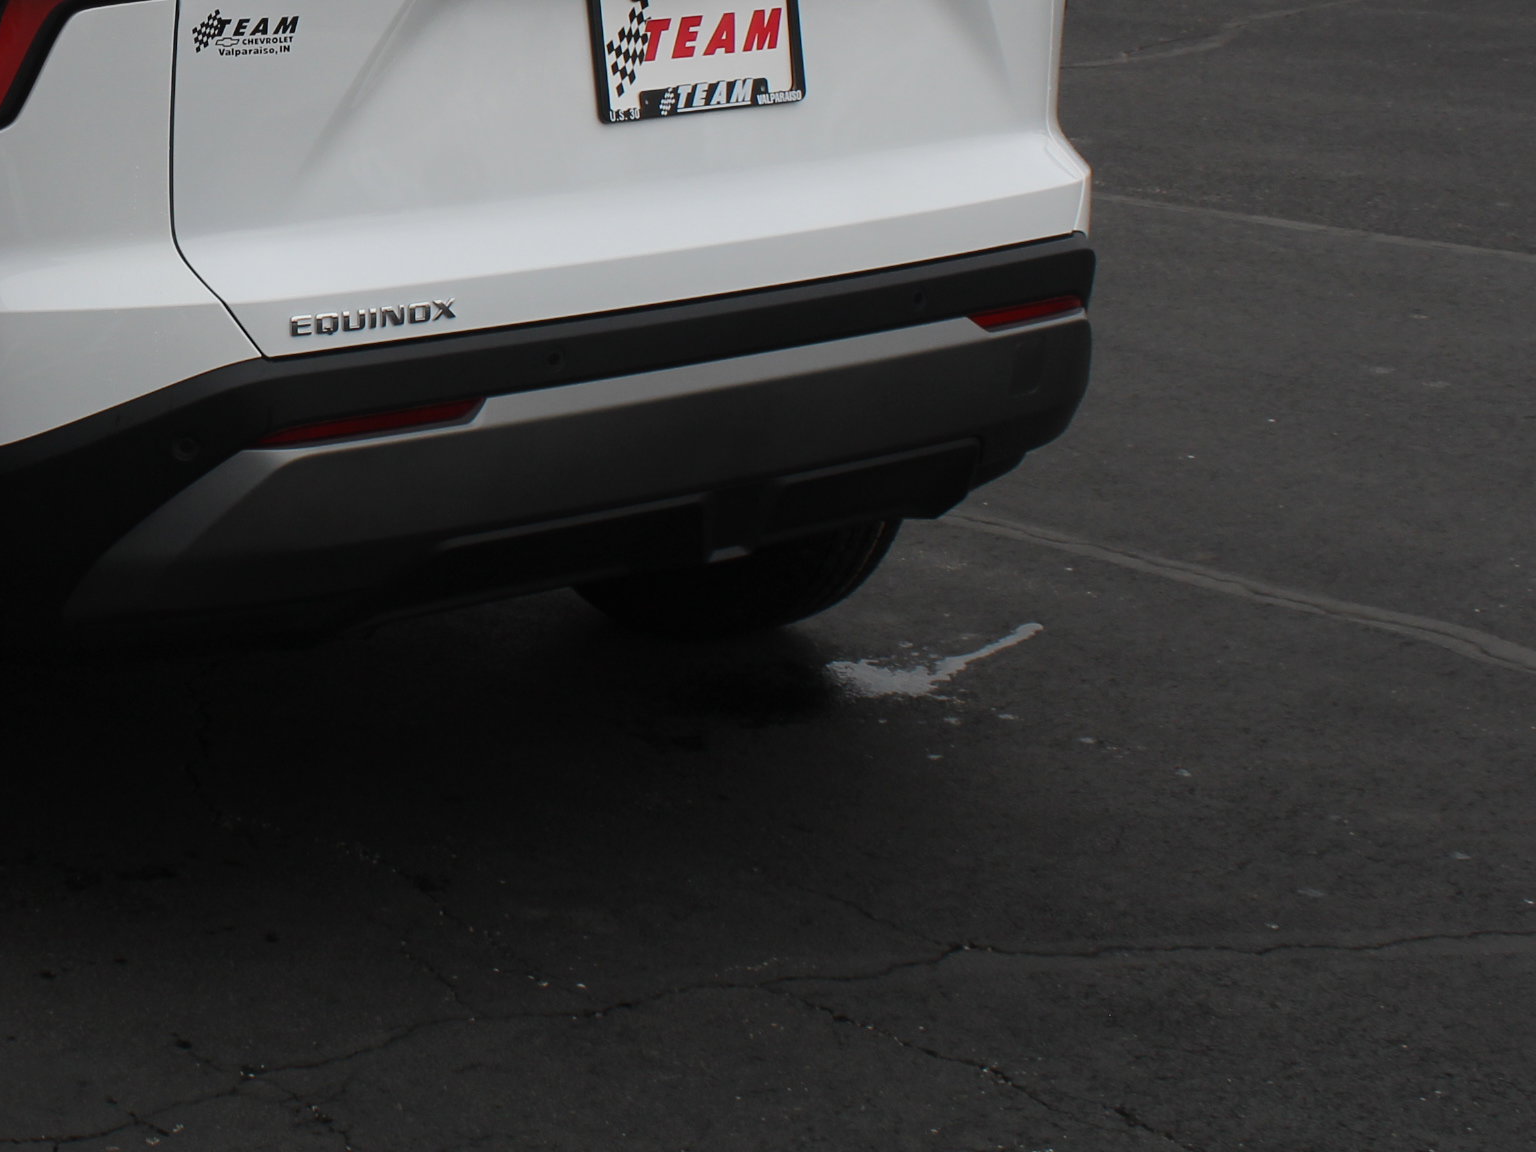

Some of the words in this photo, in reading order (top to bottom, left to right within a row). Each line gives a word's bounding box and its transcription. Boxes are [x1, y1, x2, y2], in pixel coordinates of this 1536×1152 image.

[216, 15, 300, 37] TEAM
[643, 7, 783, 62] TEAM
[241, 35, 294, 46] CHEVROLET
[218, 46, 278, 57] Valparaiso,
[279, 44, 291, 53] IN
[676, 78, 754, 109] TEAM
[756, 89, 802, 105] VALPARAISO
[609, 109, 628, 122] U.S.
[629, 108, 641, 120] 30
[289, 297, 457, 338] EQUINOX
